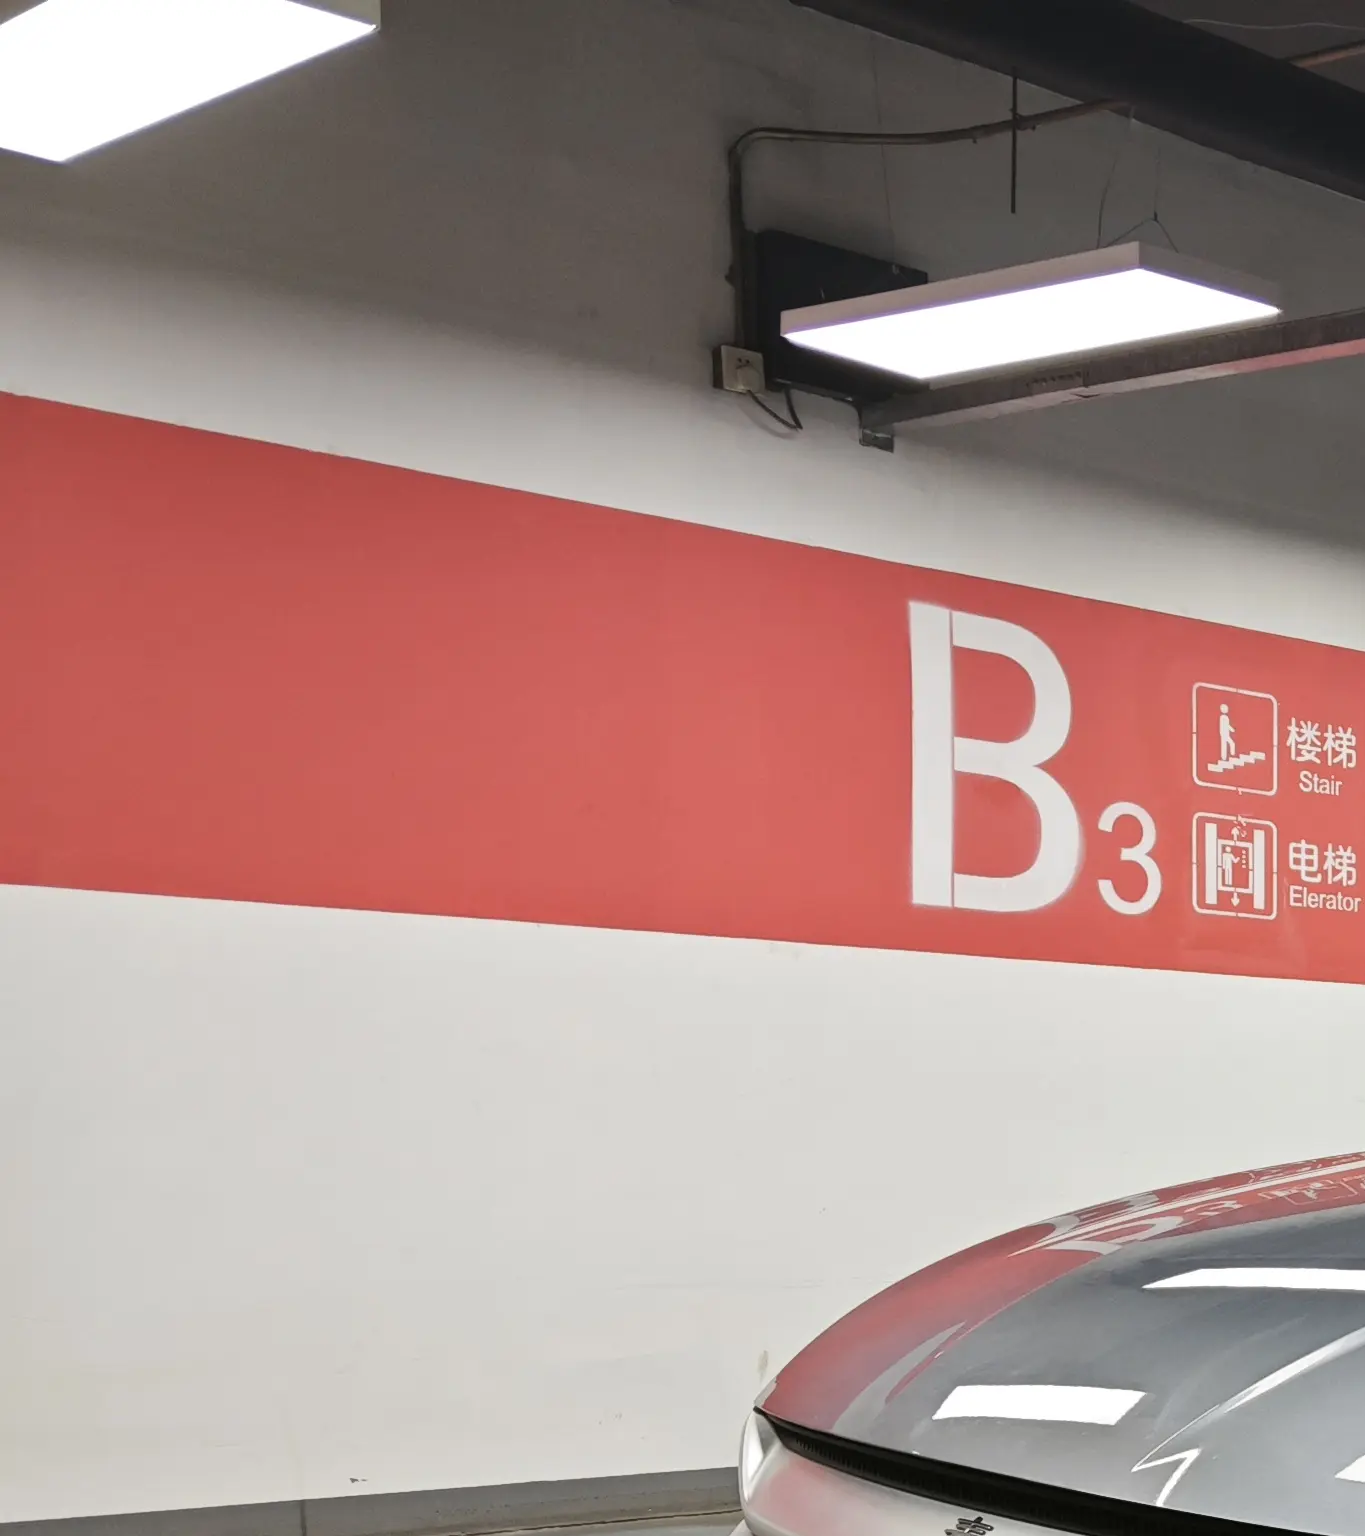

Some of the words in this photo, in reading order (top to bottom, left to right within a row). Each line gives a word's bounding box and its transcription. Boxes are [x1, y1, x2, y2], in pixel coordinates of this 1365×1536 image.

[1284, 717, 1358, 769] 楼梯
[1298, 770, 1343, 797] Stair
[1287, 838, 1358, 888] 电梯
[1289, 884, 1362, 913] Elerator
